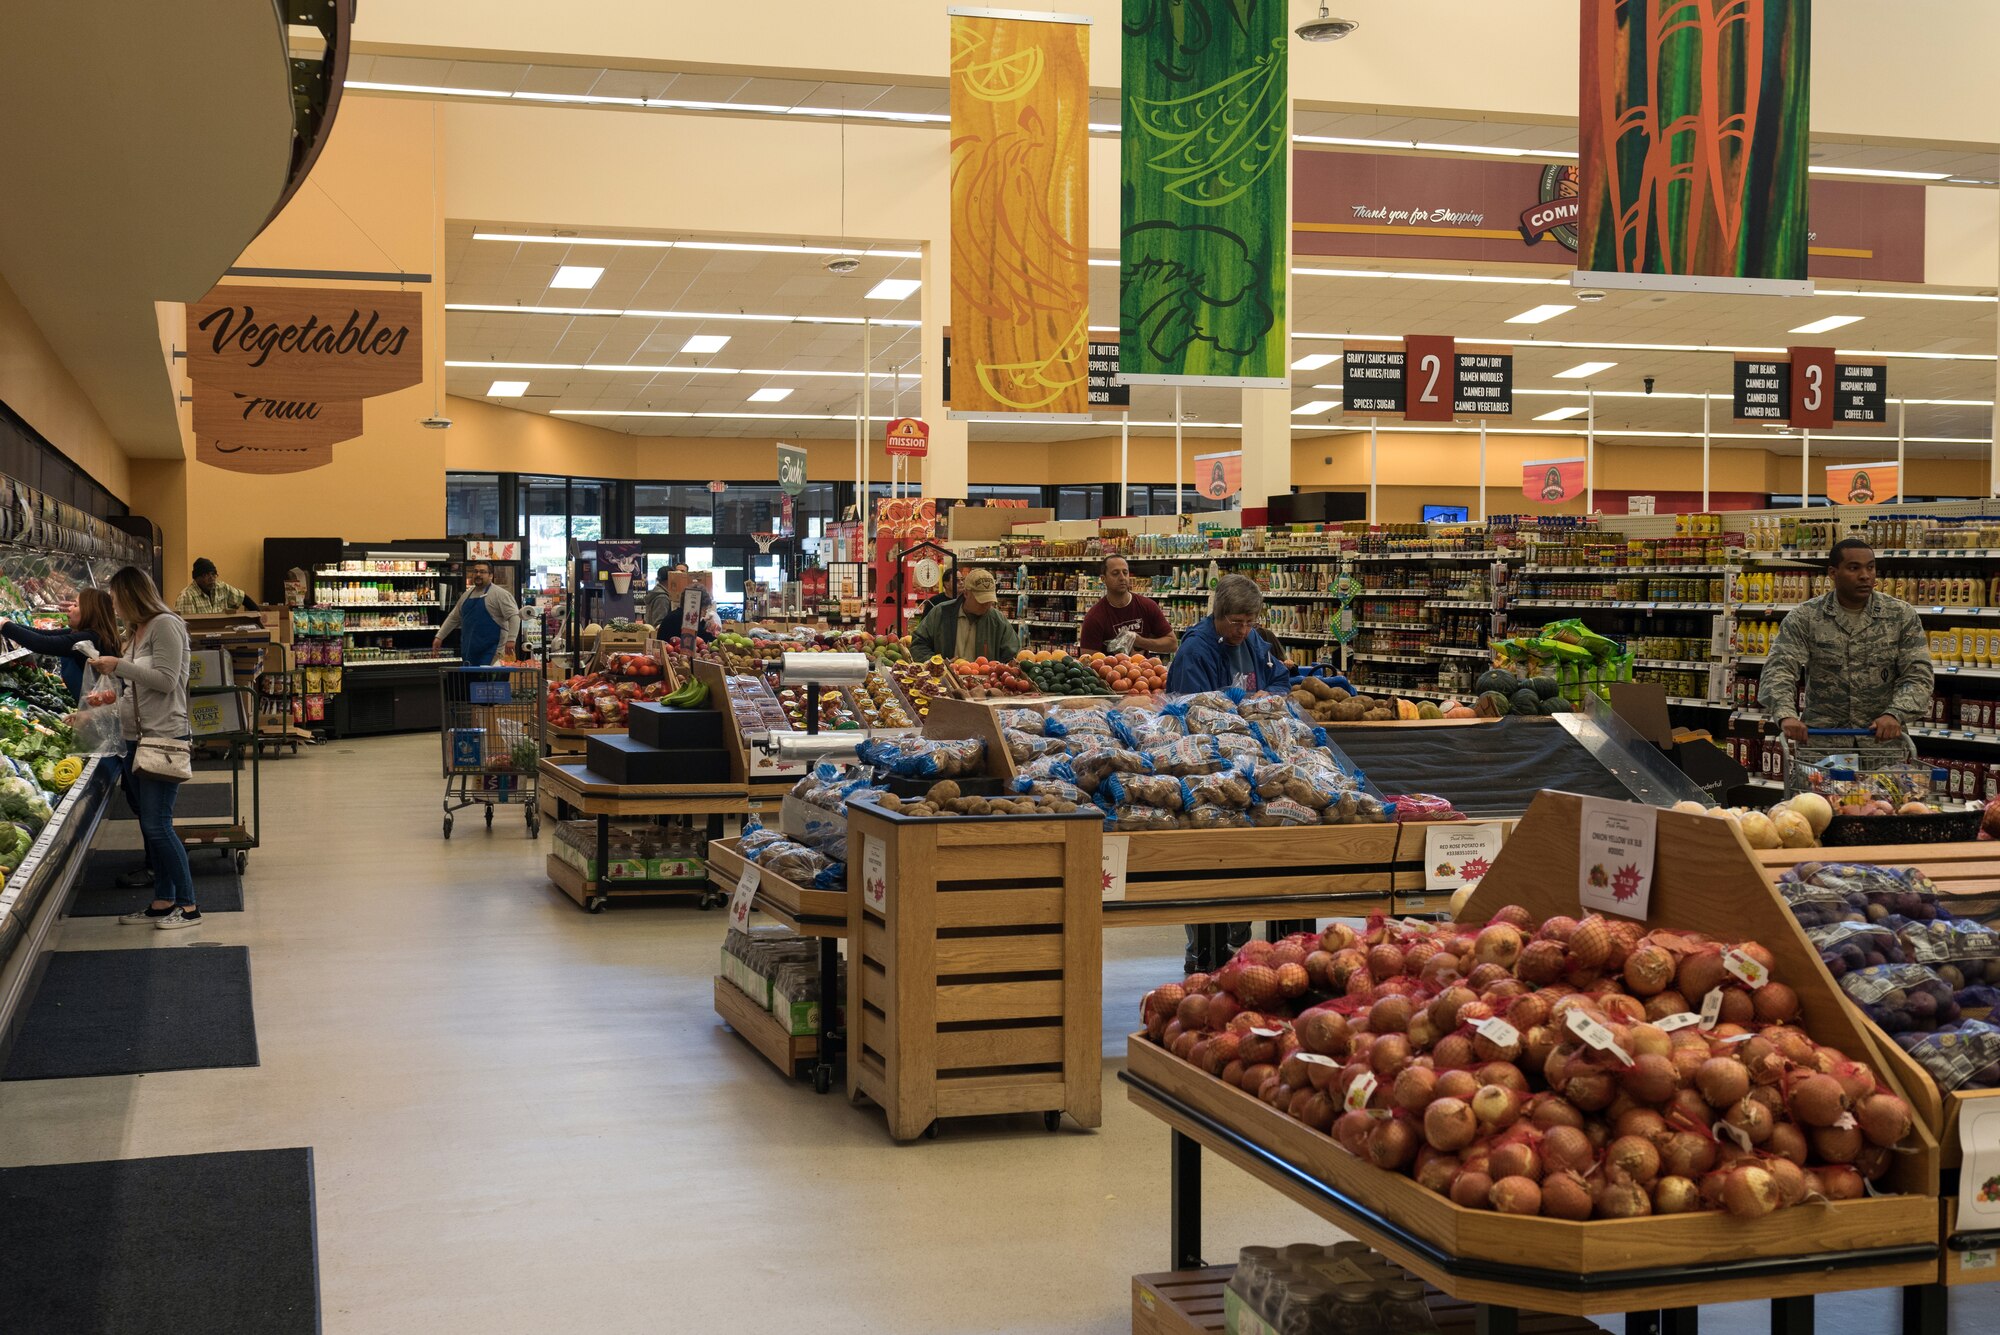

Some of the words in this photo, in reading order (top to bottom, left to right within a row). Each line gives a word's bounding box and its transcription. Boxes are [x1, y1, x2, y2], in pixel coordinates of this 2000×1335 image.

[1352, 205, 1387, 218] Thank
[1387, 210, 1409, 224] you
[1409, 208, 1428, 225] for
[1430, 208, 1483, 226] Shopping
[1531, 204, 1578, 226] COMM
[198, 305, 410, 368] Vegetables
[1097, 345, 1119, 356] BUTTER
[1346, 353, 1365, 363] GRAVY
[1368, 354, 1386, 364] SAUCE
[1387, 355, 1404, 365] MIXES
[1461, 357, 1475, 366] SOUP
[1476, 358, 1488, 367] CAN
[1491, 358, 1502, 367] DRY
[1350, 368, 1364, 378] CAKE
[1365, 369, 1400, 379] MIXES/FLOUR
[1749, 364, 1759, 374] DRY
[1760, 365, 1776, 374] BEANS
[1845, 367, 1859, 376] ASIAN
[1860, 368, 1873, 377] FOOD
[1088, 376, 1105, 387] ENING
[1419, 354, 1441, 402] 2
[1460, 372, 1479, 382] RAMEN
[1480, 372, 1503, 382] NOODLES
[1746, 379, 1765, 388] CANNED
[1766, 380, 1779, 389] MEAT
[1804, 364, 1822, 410] 3
[1841, 382, 1863, 391] HISPANIC
[1864, 382, 1876, 392] FOOD
[1464, 386, 1484, 396] CANNED
[1486, 387, 1500, 397] FRUIT
[1088, 392, 1109, 402] INEGAR
[1747, 393, 1766, 403] CANNED
[1767, 394, 1778, 403] FISH
[1853, 396, 1864, 406] RICE
[1354, 399, 1373, 409] SPICES
[1377, 400, 1395, 409] SUGAR
[1455, 401, 1476, 411] CANNED
[1478, 402, 1509, 412] VEGETABLES
[1744, 407, 1764, 416] CANNED
[1765, 407, 1780, 417] PASTA
[1845, 410, 1862, 419] COFFEE
[1865, 410, 1874, 419] TEA
[781, 456, 803, 485] Sushi
[192, 705, 219, 715] GOLDEN
[193, 711, 219, 721] WEST
